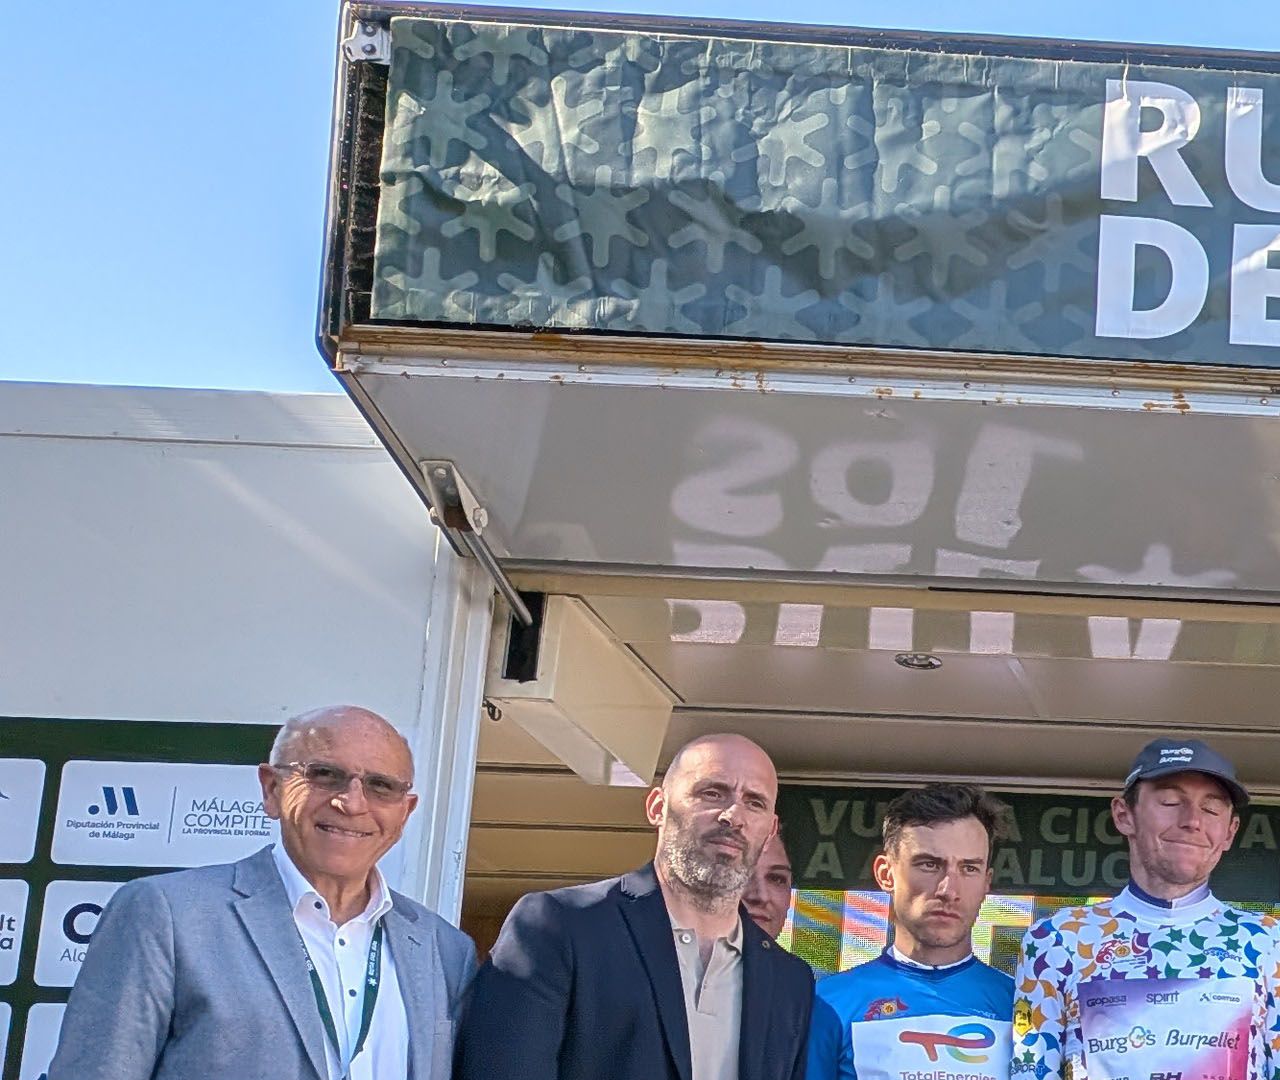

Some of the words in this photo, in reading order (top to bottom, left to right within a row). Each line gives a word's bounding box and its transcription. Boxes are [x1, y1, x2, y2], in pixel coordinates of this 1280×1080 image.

[191, 797, 265, 812] MÁLAGA
[66, 819, 115, 831] Diputación
[117, 821, 160, 830] Provincial
[184, 813, 272, 830] COMPITE
[88, 830, 100, 838] de
[102, 830, 135, 840] Málaga
[1166, 1029, 1241, 1049] Burpellet
